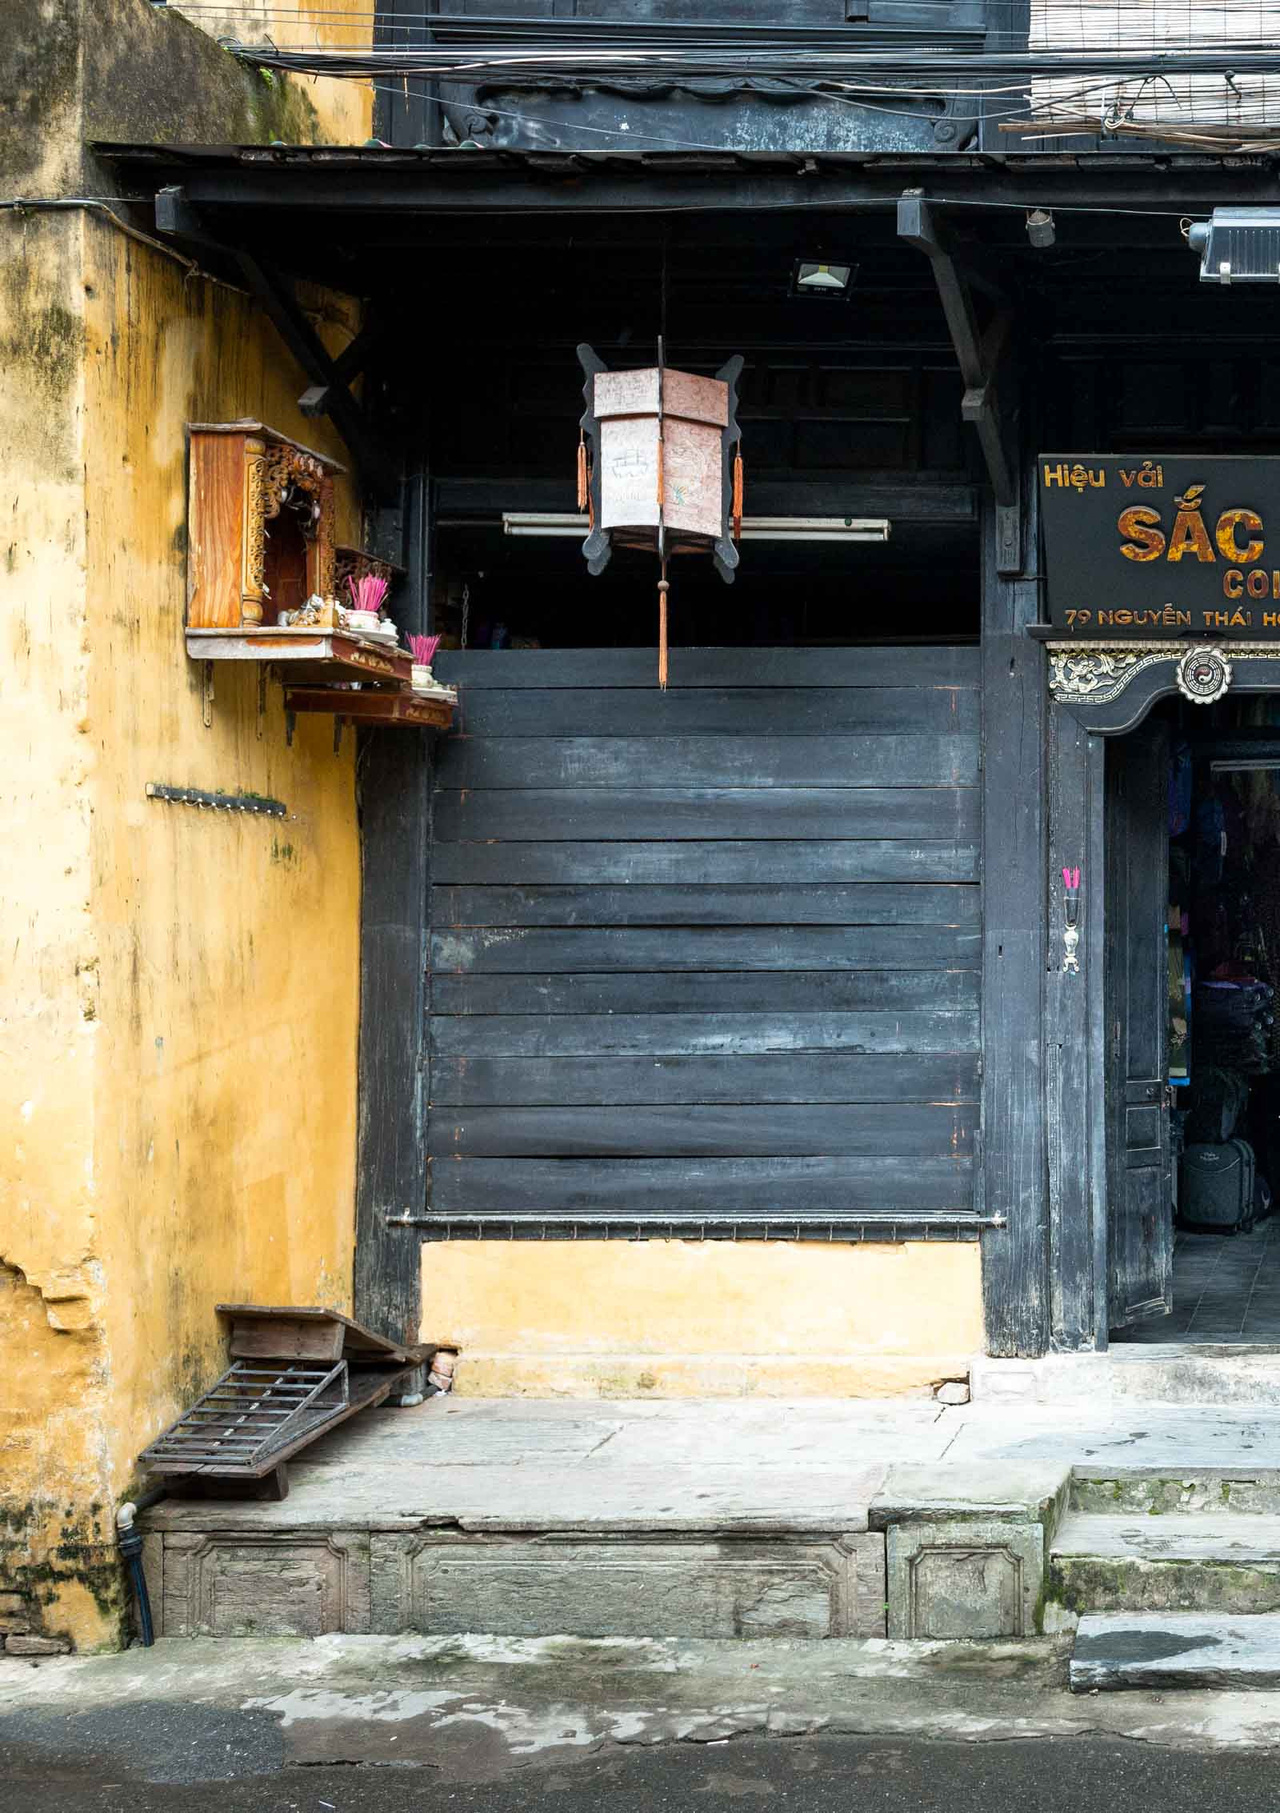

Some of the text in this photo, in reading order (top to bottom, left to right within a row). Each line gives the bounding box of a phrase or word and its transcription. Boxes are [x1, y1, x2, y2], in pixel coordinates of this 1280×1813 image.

[1044, 460, 1164, 493] Hiệu vải
[1117, 484, 1264, 563] SẮC
[1064, 609, 1092, 625] 79
[1097, 602, 1192, 627] NGUYỄN
[1202, 606, 1251, 627] THÁI
